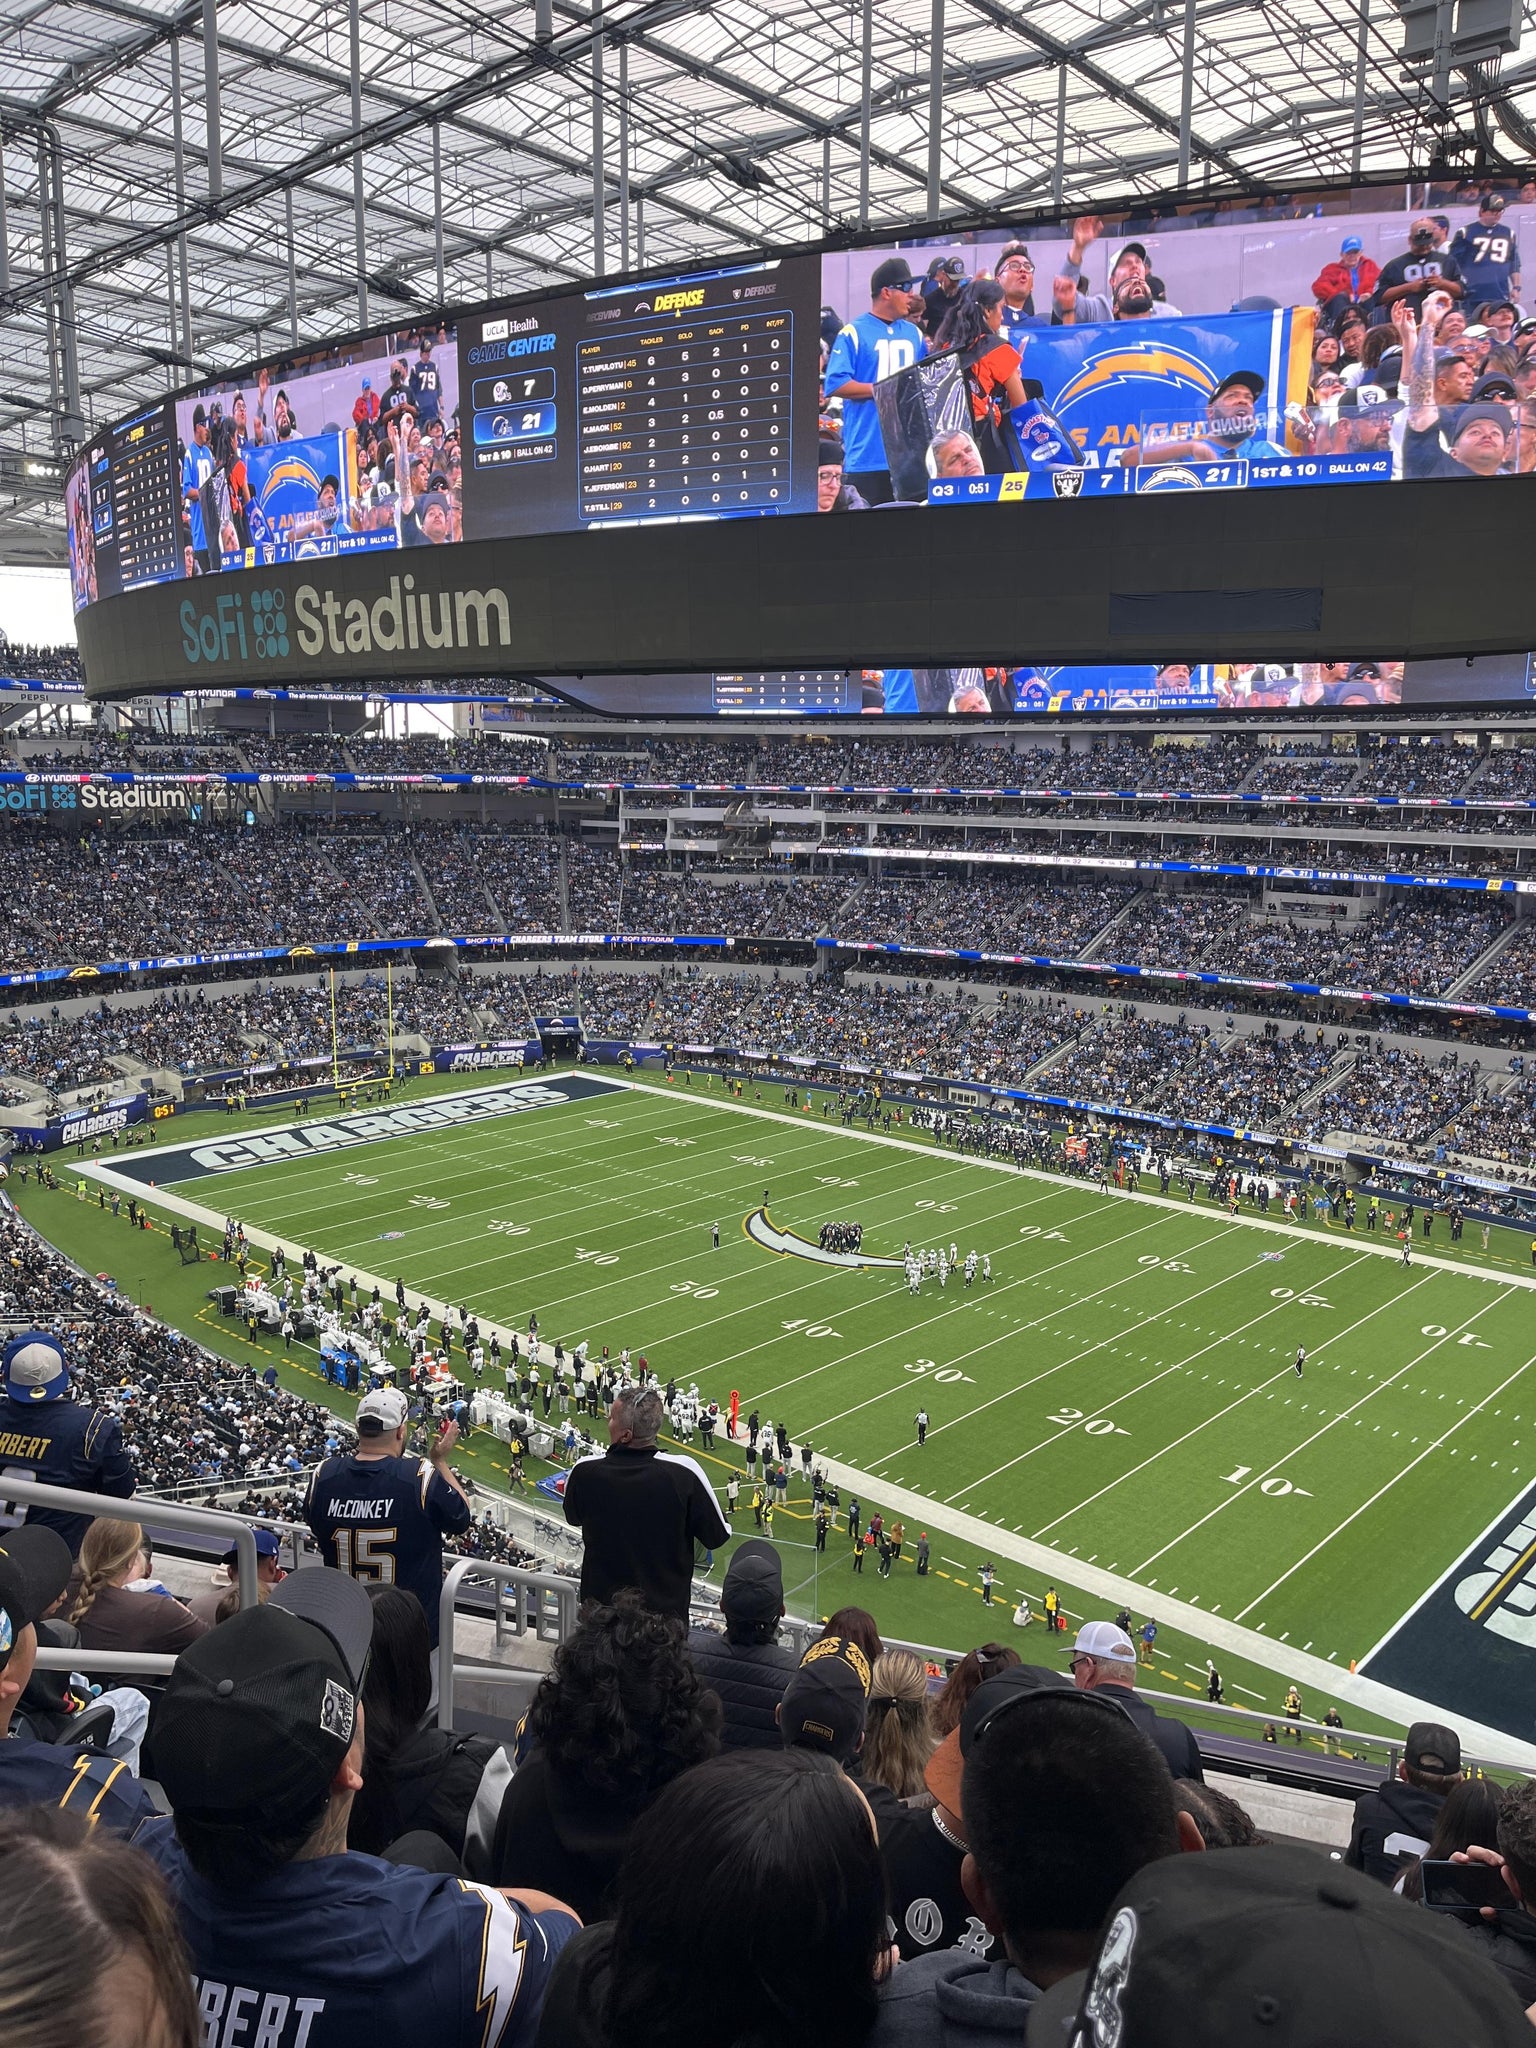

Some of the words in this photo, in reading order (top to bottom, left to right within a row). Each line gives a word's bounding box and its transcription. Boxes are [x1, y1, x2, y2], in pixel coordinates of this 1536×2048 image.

[1473, 237, 1508, 263] 79
[744, 284, 777, 297] DEFENSE
[654, 289, 705, 312] DEFENSE
[486, 325, 504, 336] UCLA
[510, 317, 538, 333] Health
[468, 342, 507, 364] GAME
[508, 333, 556, 357] CENTER
[582, 346, 600, 354] PLAYER
[640, 337, 664, 346] TACKLES
[648, 356, 655, 366] 6
[682, 352, 689, 360] 5
[712, 347, 720, 356] 2
[742, 343, 748, 352] 1
[770, 339, 780, 349] 0
[419, 372, 436, 390] 79
[648, 376, 656, 386] 4
[682, 372, 689, 382] 3
[712, 368, 720, 378] 0
[740, 364, 748, 374] 0
[770, 360, 780, 370] 0
[524, 379, 535, 396] 7
[620, 402, 626, 410] 2
[648, 398, 656, 406] 4
[683, 393, 688, 402] 1
[712, 390, 720, 399] 0
[740, 386, 748, 396] 0
[770, 382, 780, 392] 0
[522, 412, 540, 430] 21
[614, 422, 622, 430] 52
[648, 418, 656, 427] 3
[682, 414, 689, 424] 2
[708, 410, 724, 420] 0.5
[740, 407, 748, 416] 0
[772, 404, 778, 414] 1
[622, 442, 632, 450] 92
[648, 438, 656, 448] 2
[682, 434, 689, 444] 2
[712, 431, 720, 440] 0
[740, 428, 748, 438] 0
[770, 425, 778, 434] 0
[478, 453, 491, 463] 1ST
[493, 451, 500, 461] &
[500, 450, 512, 460] 10
[517, 447, 533, 457] BALL
[534, 446, 543, 456] ON
[544, 445, 552, 454] 42
[648, 458, 656, 468] 2
[682, 455, 689, 464] 2
[712, 452, 720, 461] 0
[740, 449, 748, 458] 0
[770, 446, 778, 456] 0
[628, 481, 637, 489] 23
[648, 478, 656, 488] 2
[683, 476, 688, 484] 1
[712, 472, 720, 482] 0
[742, 470, 747, 480] 1
[772, 468, 777, 476] 1
[1100, 474, 1113, 488] 7
[1205, 468, 1230, 482] 21
[1252, 466, 1278, 478] 1ST
[1280, 464, 1292, 477] &
[1296, 463, 1316, 476] 10
[1329, 463, 1353, 474] BALL
[1355, 463, 1369, 472] ON
[1372, 462, 1386, 472] 42
[932, 484, 954, 497] Q3
[968, 482, 990, 494] 0:51
[1005, 480, 1022, 492] 25
[649, 498, 656, 508] 2
[682, 496, 690, 504] 0
[712, 493, 720, 502] 0
[740, 490, 748, 500] 0
[770, 488, 778, 498] 0
[280, 548, 286, 557] 7
[320, 540, 331, 551] 21
[179, 593, 249, 663] SoFi
[295, 574, 511, 656] Stadium
[21, 694, 48, 702] PEPSI
[126, 698, 152, 706] PEPSI
[198, 690, 236, 698] HYUNDAI
[42, 774, 80, 782] HYUNDAI
[273, 774, 308, 782] HYUNDAI
[81, 784, 185, 808] Stadium
[510, 936, 552, 944] CHARGERS
[554, 936, 578, 944] TEAM
[1332, 989, 1364, 999] HYUNDAI
[422, 1062, 433, 1072] 25
[154, 1105, 174, 1118] 0:51
[62, 1108, 127, 1144] CHARGERS
[190, 1085, 569, 1170] CHARGERS
[659, 1136, 697, 1147] 20
[736, 1155, 775, 1167] 30
[341, 1174, 379, 1186] 10
[821, 1176, 860, 1188] 40
[408, 1197, 450, 1209] 20
[915, 1199, 959, 1213] 50
[487, 1221, 530, 1236] 30
[1019, 1225, 1067, 1242] 40
[574, 1249, 620, 1265] 40
[1137, 1255, 1190, 1272] 30
[670, 1280, 719, 1299] 50
[1270, 1287, 1328, 1307] 20
[781, 1319, 832, 1338] 40
[1421, 1324, 1482, 1346] 10
[903, 1358, 963, 1383] 30
[1045, 1407, 1115, 1435] 20
[1219, 1464, 1293, 1497] 10
[328, 1498, 394, 1518] McCONKEY
[332, 1528, 398, 1585] 15
[190, 1974, 326, 2048] BERT
